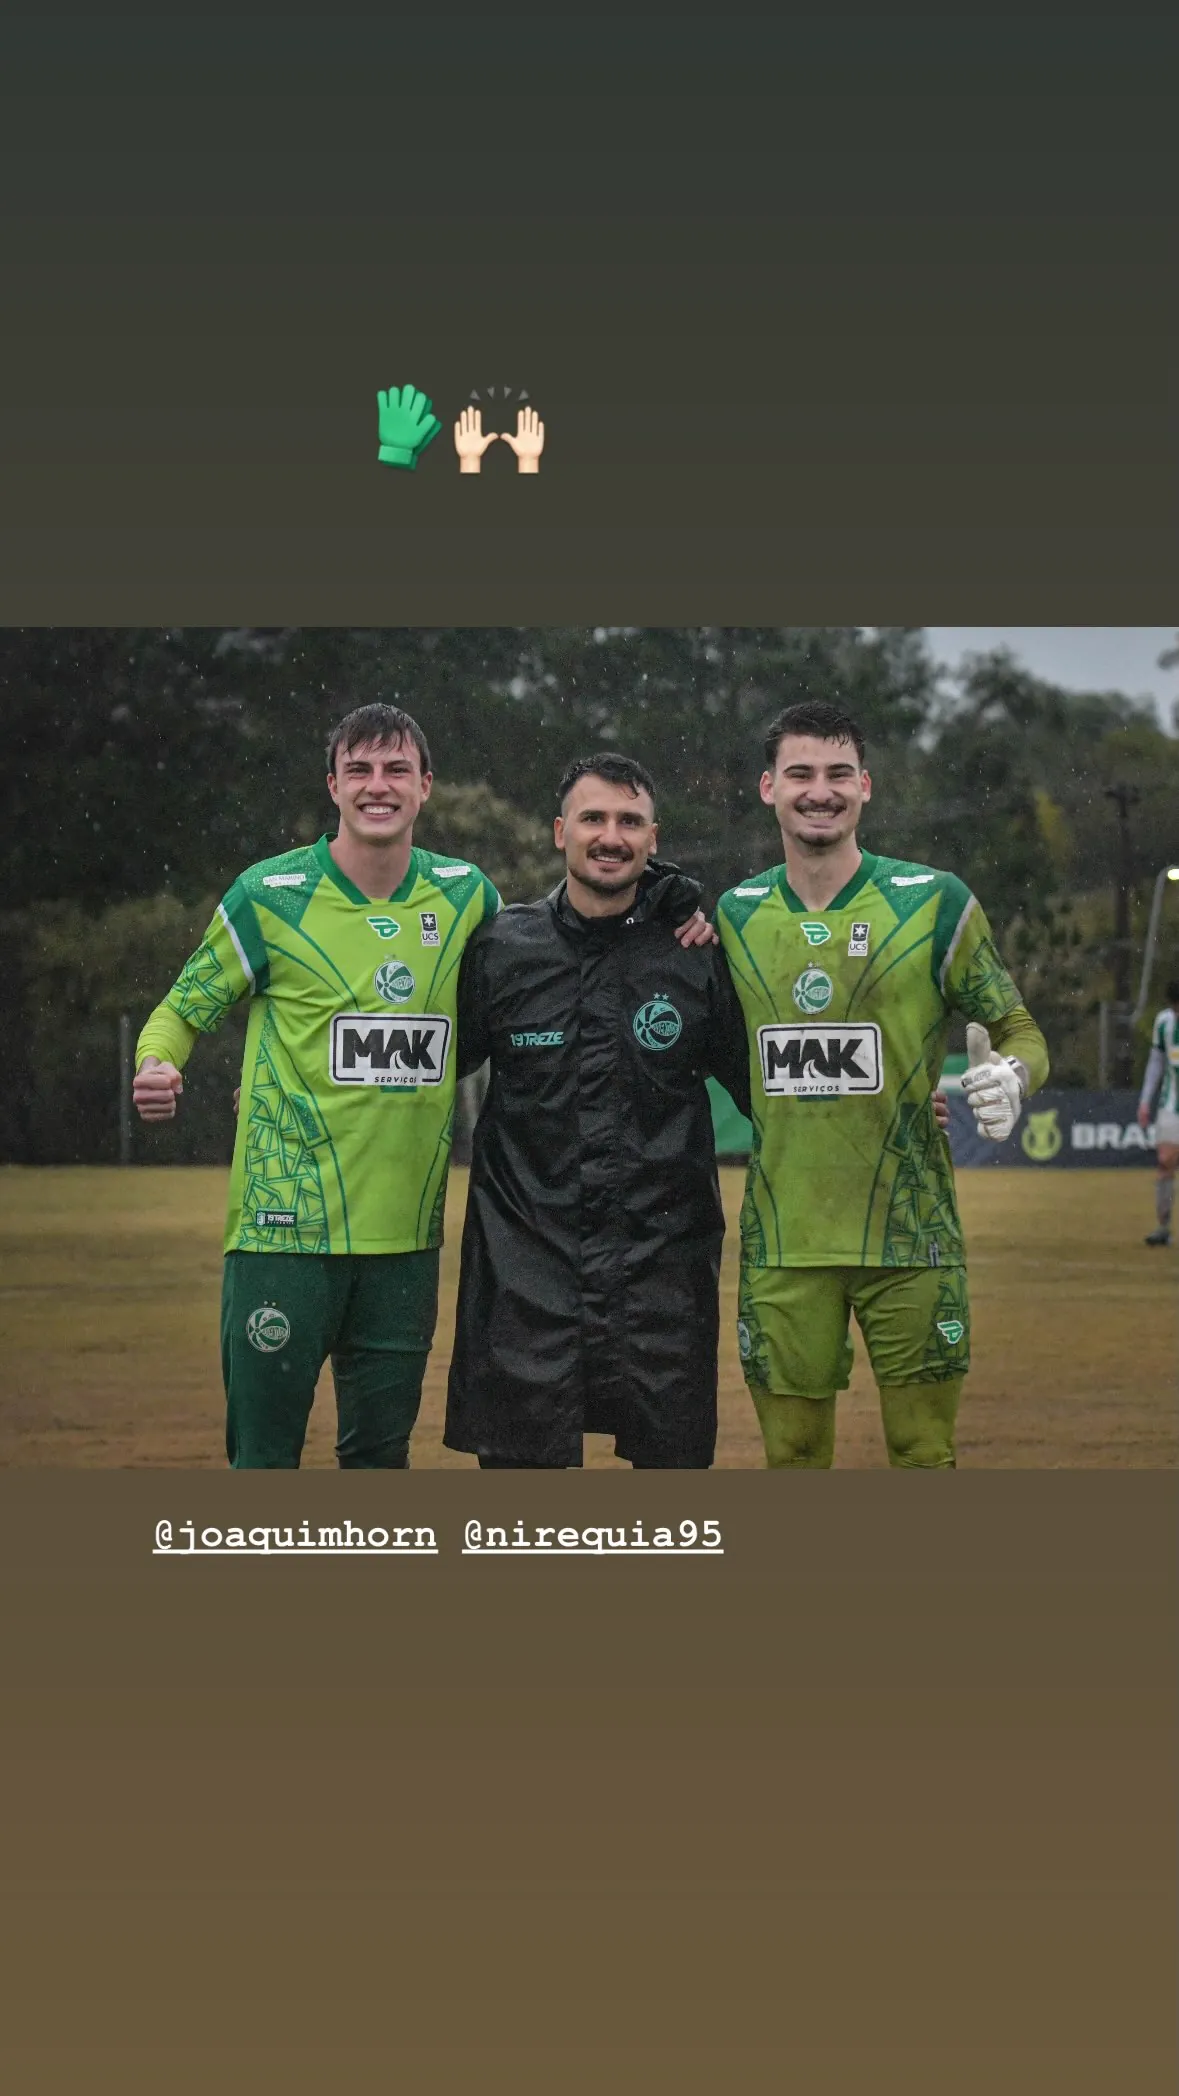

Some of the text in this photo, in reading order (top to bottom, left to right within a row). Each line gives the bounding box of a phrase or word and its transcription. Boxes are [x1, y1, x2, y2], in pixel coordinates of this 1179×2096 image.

[422, 932, 439, 941] UCS
[849, 943, 867, 951] UCS
[342, 1028, 437, 1070] MAK
[767, 1038, 870, 1080] MAK
[793, 1085, 840, 1093] SERVIÇOS
